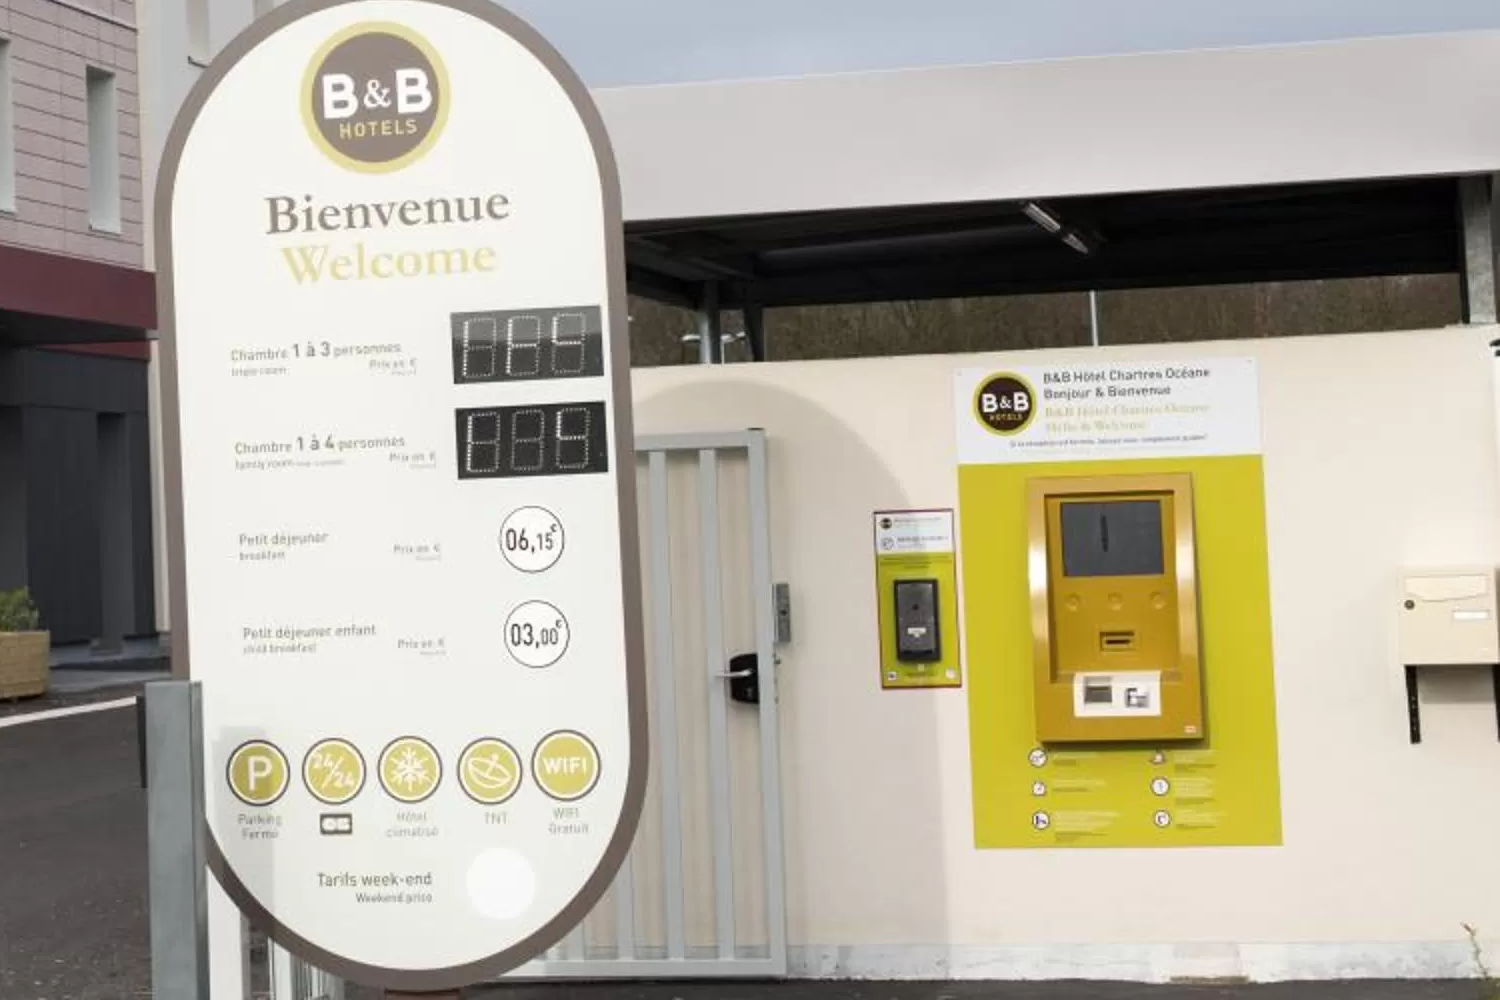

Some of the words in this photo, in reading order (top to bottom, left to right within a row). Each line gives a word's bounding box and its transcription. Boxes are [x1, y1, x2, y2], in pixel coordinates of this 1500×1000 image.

[322, 67, 433, 119] B&B
[339, 119, 418, 139] HOTELS
[264, 192, 510, 235] Bienvenue
[281, 242, 497, 286] Welcome
[231, 347, 288, 361] Chambre
[292, 344, 301, 358] 1
[306, 341, 316, 357] à
[320, 341, 331, 357] 3
[334, 343, 402, 358] personnes
[1043, 370, 1070, 384] B&B
[1109, 368, 1162, 381] Chartres
[1165, 366, 1210, 380] Océane
[981, 391, 1029, 413] B&B
[1043, 387, 1092, 401] Bonjour
[1107, 385, 1171, 398] Bienvenue
[234, 441, 292, 455] Chambre
[296, 436, 304, 451] 1
[309, 433, 320, 450] à
[325, 434, 335, 449] 4
[337, 437, 405, 451] personnes
[239, 533, 269, 546] Petit
[243, 627, 272, 640] Petit
[335, 624, 376, 637] enfant
[247, 755, 273, 792] P
[541, 756, 588, 776] WIFI
[238, 813, 283, 829] Parking
[484, 811, 508, 825] TNT
[548, 823, 589, 835] Gratuit
[317, 872, 357, 887] Tarifs
[361, 871, 433, 887] week-end
